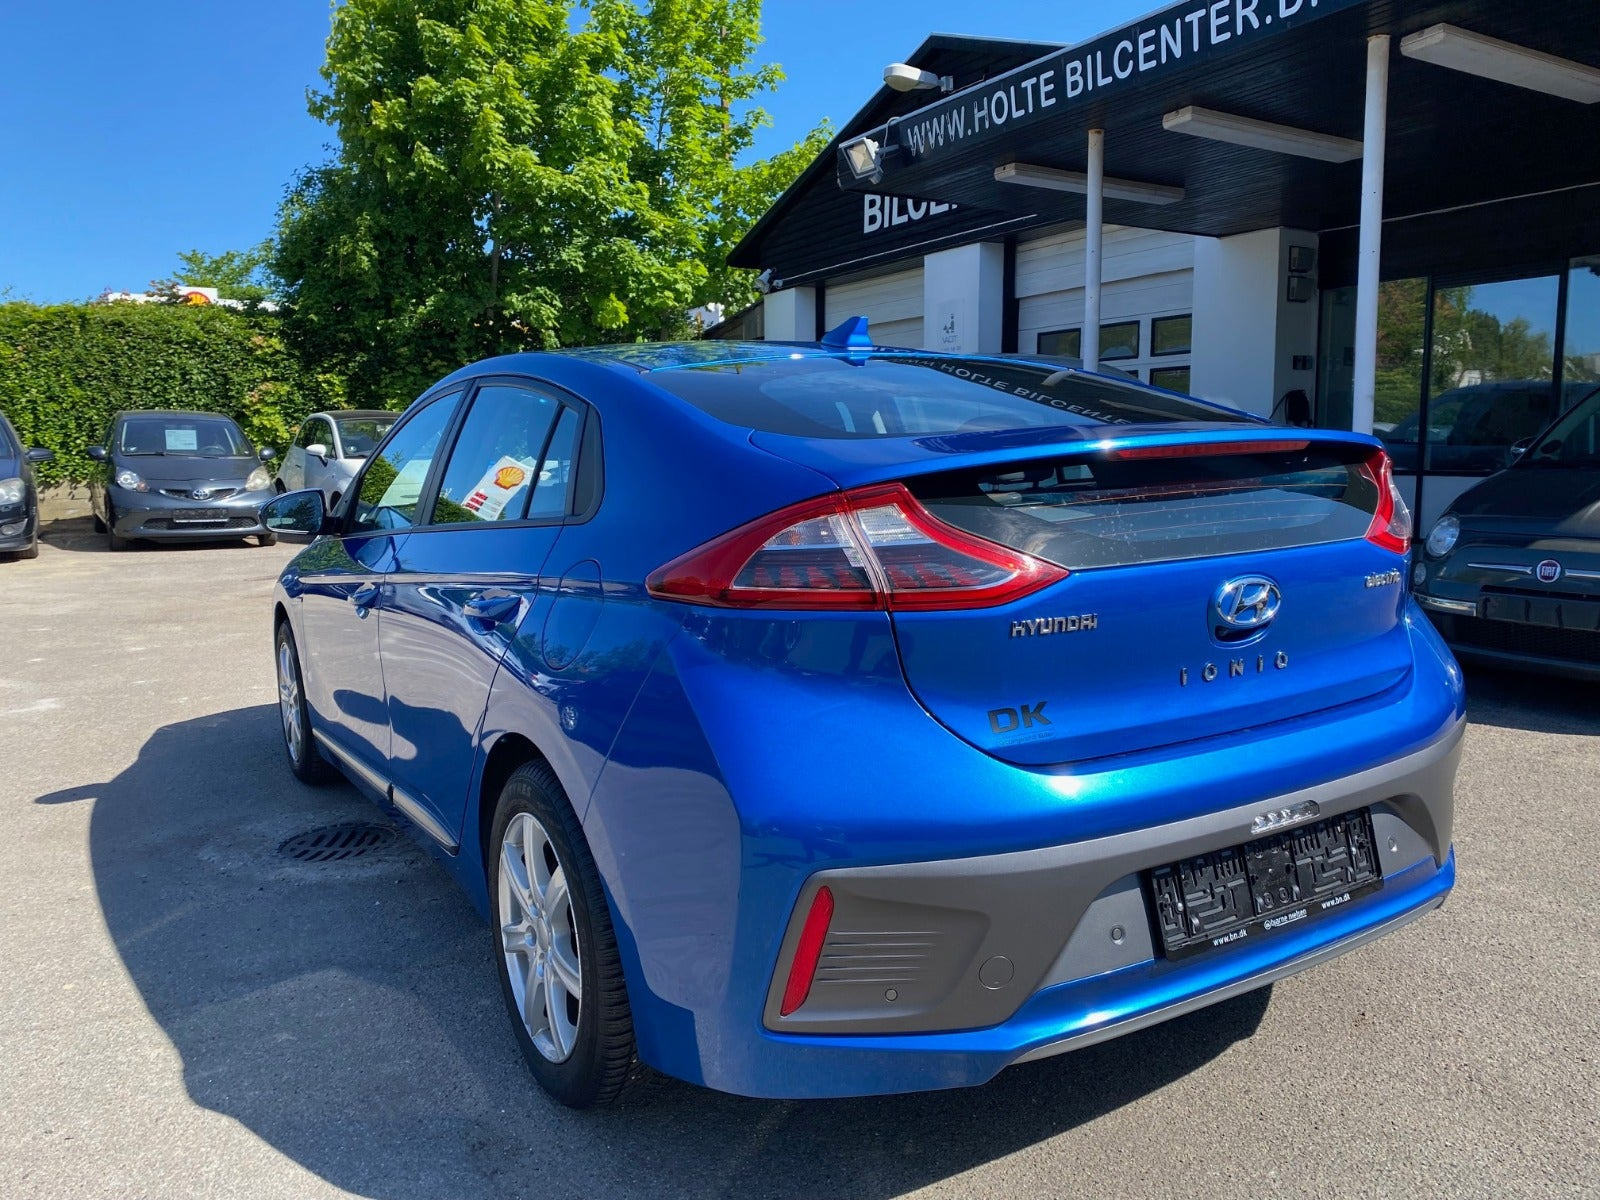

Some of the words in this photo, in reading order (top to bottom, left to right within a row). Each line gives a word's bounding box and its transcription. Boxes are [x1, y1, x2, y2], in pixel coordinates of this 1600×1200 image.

[907, 70, 1056, 157] WWW.HOLTE
[1066, 0, 1318, 99] BILCENTER.
[863, 193, 958, 234] BILC
[1541, 565, 1557, 577] FIAT
[1011, 612, 1098, 637] HYUNDAI
[1180, 651, 1289, 687] IONIQ
[988, 701, 1051, 734] DK
